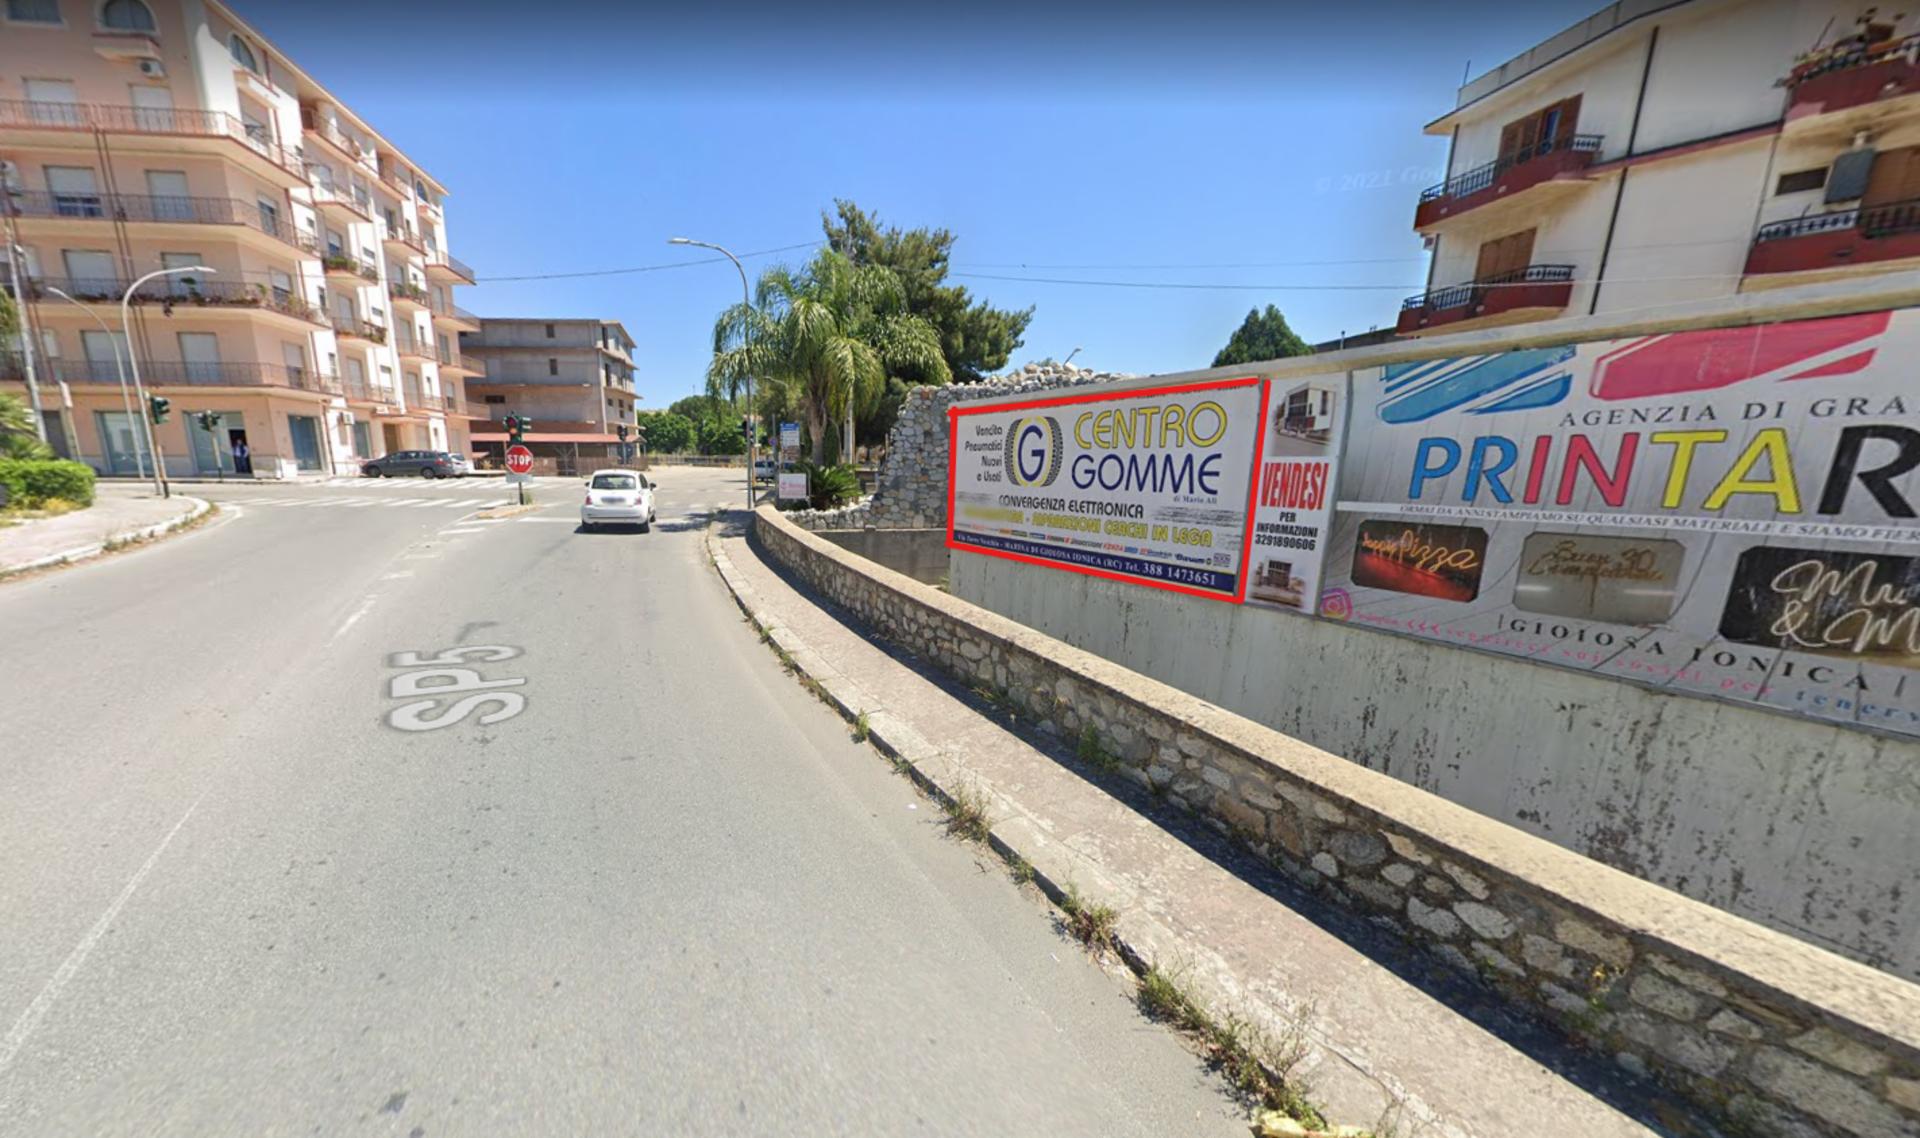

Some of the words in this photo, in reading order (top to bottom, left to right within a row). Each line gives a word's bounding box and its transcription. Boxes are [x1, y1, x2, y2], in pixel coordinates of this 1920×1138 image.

[1074, 401, 1228, 449] CENTRO
[1559, 402, 1717, 428] AGENZIA
[1741, 401, 1785, 420] DI
[1809, 396, 1920, 418] GRA
[507, 454, 531, 466] STOP
[1072, 453, 1223, 495] GOMME
[1260, 462, 1329, 511] VENDESI
[998, 495, 1065, 511] CONVERGENZA
[1068, 499, 1144, 519] ELETTRONICA
[1279, 511, 1297, 523] PER
[1151, 523, 1169, 543] IN
[1172, 526, 1213, 548] LEGA
[1257, 522, 1318, 538] INFORMAZIONI
[1398, 529, 1479, 572] Pizza
[1103, 559, 1123, 571] (RC)
[1143, 563, 1163, 576] 388
[1168, 567, 1216, 585] 1473651
[1510, 618, 1664, 655] GIOIOSA
[1691, 646, 1870, 691] IONICA
